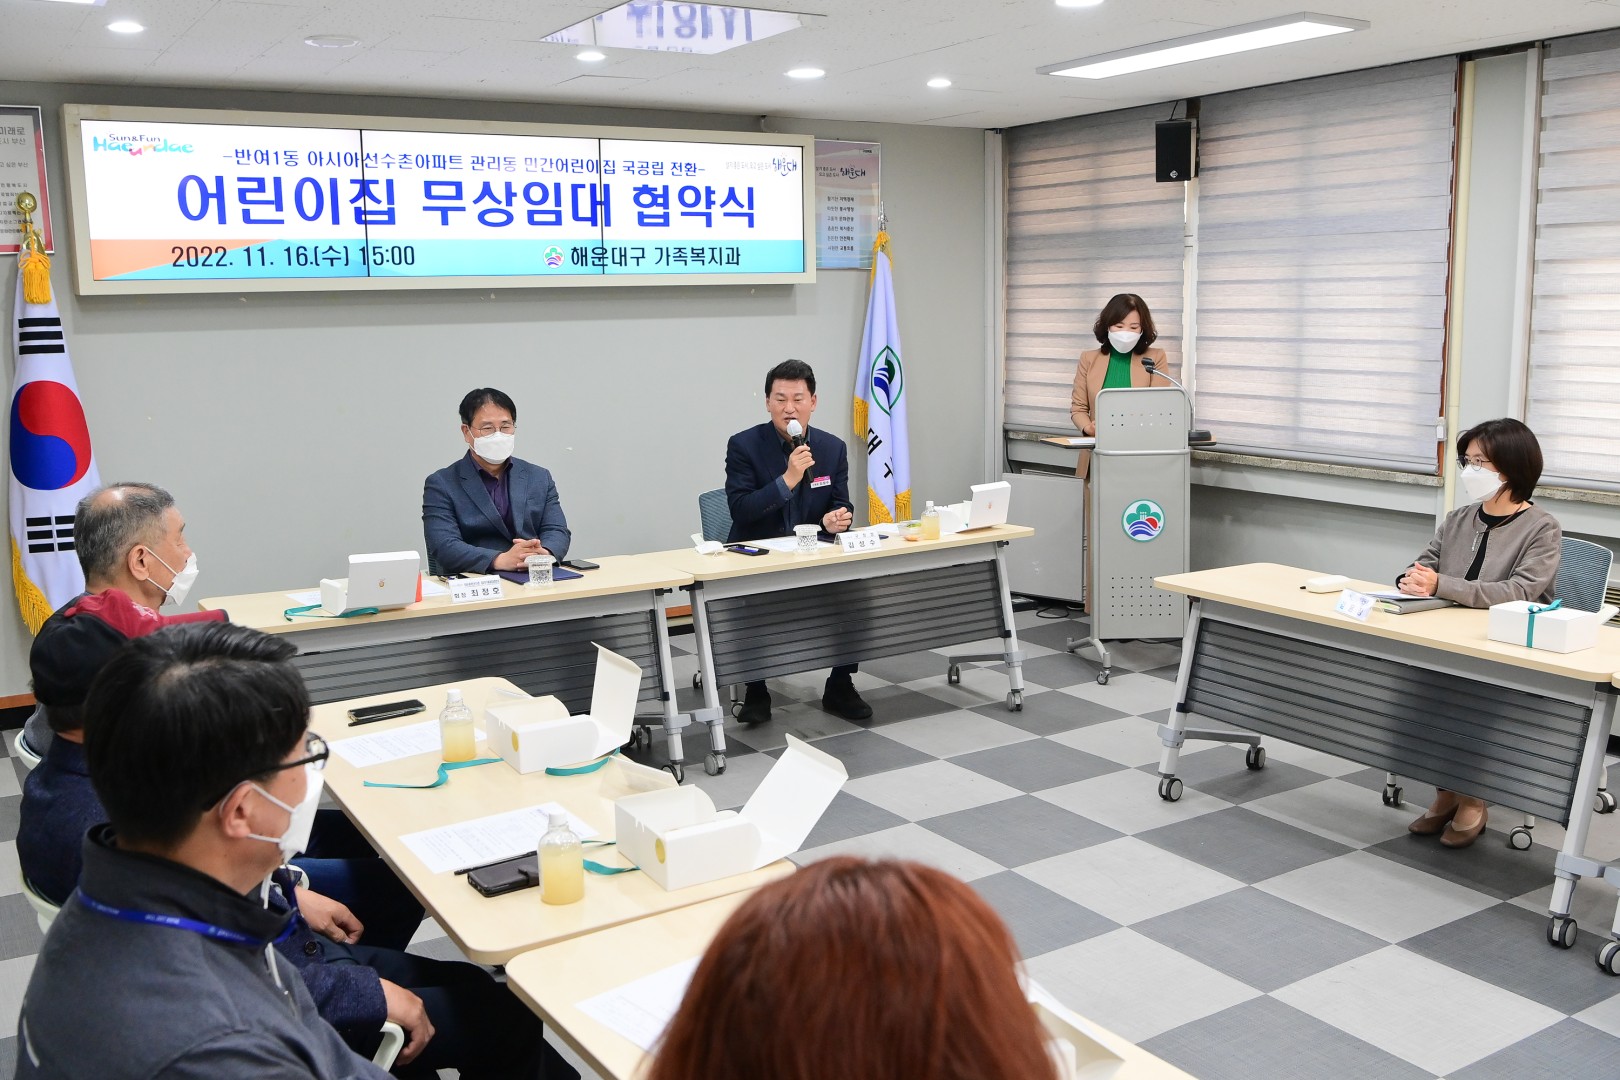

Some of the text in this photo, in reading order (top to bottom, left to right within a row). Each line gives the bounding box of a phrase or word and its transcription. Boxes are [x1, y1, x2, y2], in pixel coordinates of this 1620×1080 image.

[109, 133, 161, 142] Sun&Fun
[307, 150, 464, 170] 아시아선수촌아파트
[470, 155, 517, 172] 관리동
[524, 157, 616, 175] 민간어린이집
[622, 160, 665, 177] 국공립
[840, 167, 866, 179] 해운대
[176, 174, 755, 228] 어린이집 무상임대 협약식
[172, 245, 416, 268] 2022. 11. 16.(수) 15:00
[570, 246, 741, 267] 해운대구 가족복지과
